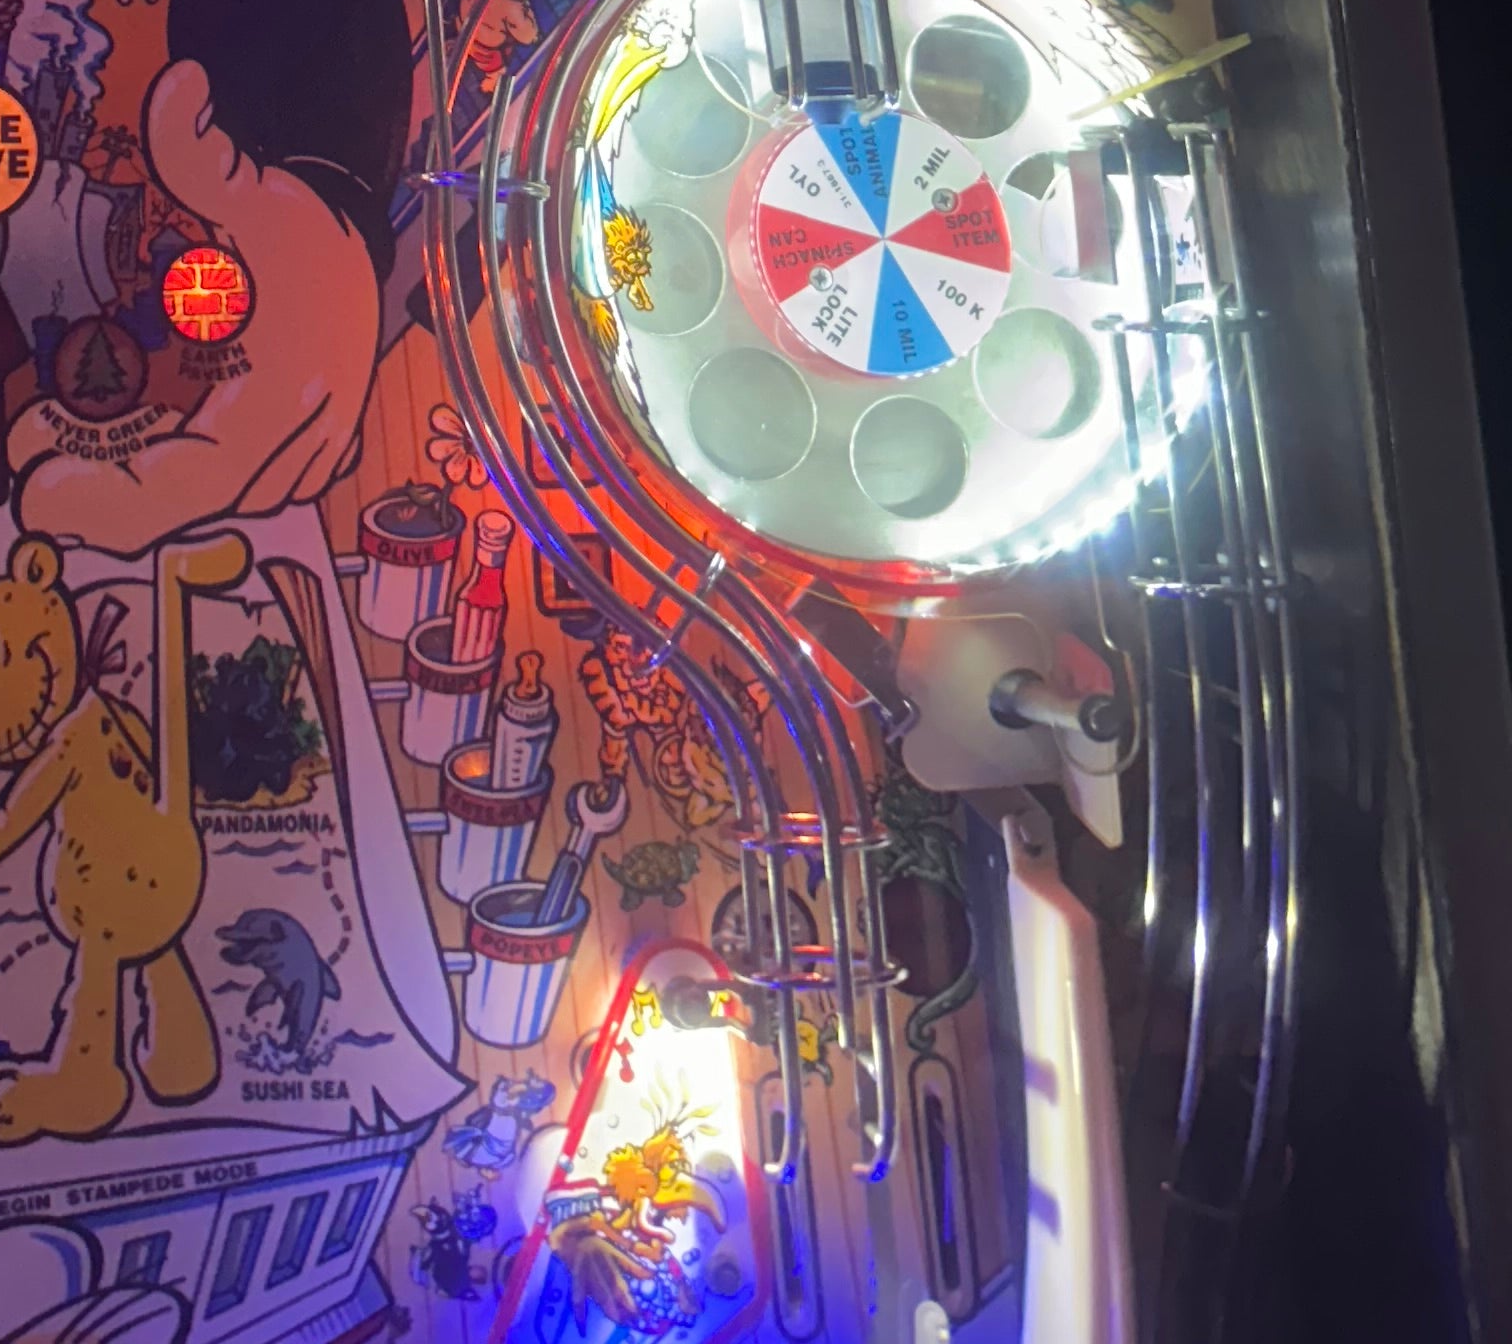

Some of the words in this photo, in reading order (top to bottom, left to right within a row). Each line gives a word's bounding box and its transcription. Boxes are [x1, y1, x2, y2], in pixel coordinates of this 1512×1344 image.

[839, 127, 862, 177] SPOT
[789, 164, 821, 198] OYL
[913, 175, 928, 190] 2
[925, 147, 951, 177] MIL
[944, 211, 995, 230] SPOT
[768, 228, 807, 248] CAN
[952, 230, 1001, 249] ITEM
[772, 241, 855, 270] SPINACH
[811, 284, 849, 333] LOCK
[891, 300, 909, 321] 10
[936, 279, 968, 308] 100
[968, 303, 986, 321] K
[826, 306, 858, 348] LITE
[180, 341, 246, 364] EARTH
[897, 328, 918, 364] MIL
[39, 402, 101, 444] NEVER
[106, 402, 169, 443] GREEN
[55, 434, 143, 461] LOGGING
[377, 541, 435, 563] OLIVE
[202, 812, 331, 835] PANDAMONIA
[480, 930, 560, 959] POPEYE
[241, 1081, 304, 1102] SUSHI
[310, 1080, 350, 1101] SEA
[65, 1172, 185, 1206] STAMPEDE
[193, 1162, 259, 1185] MODE
